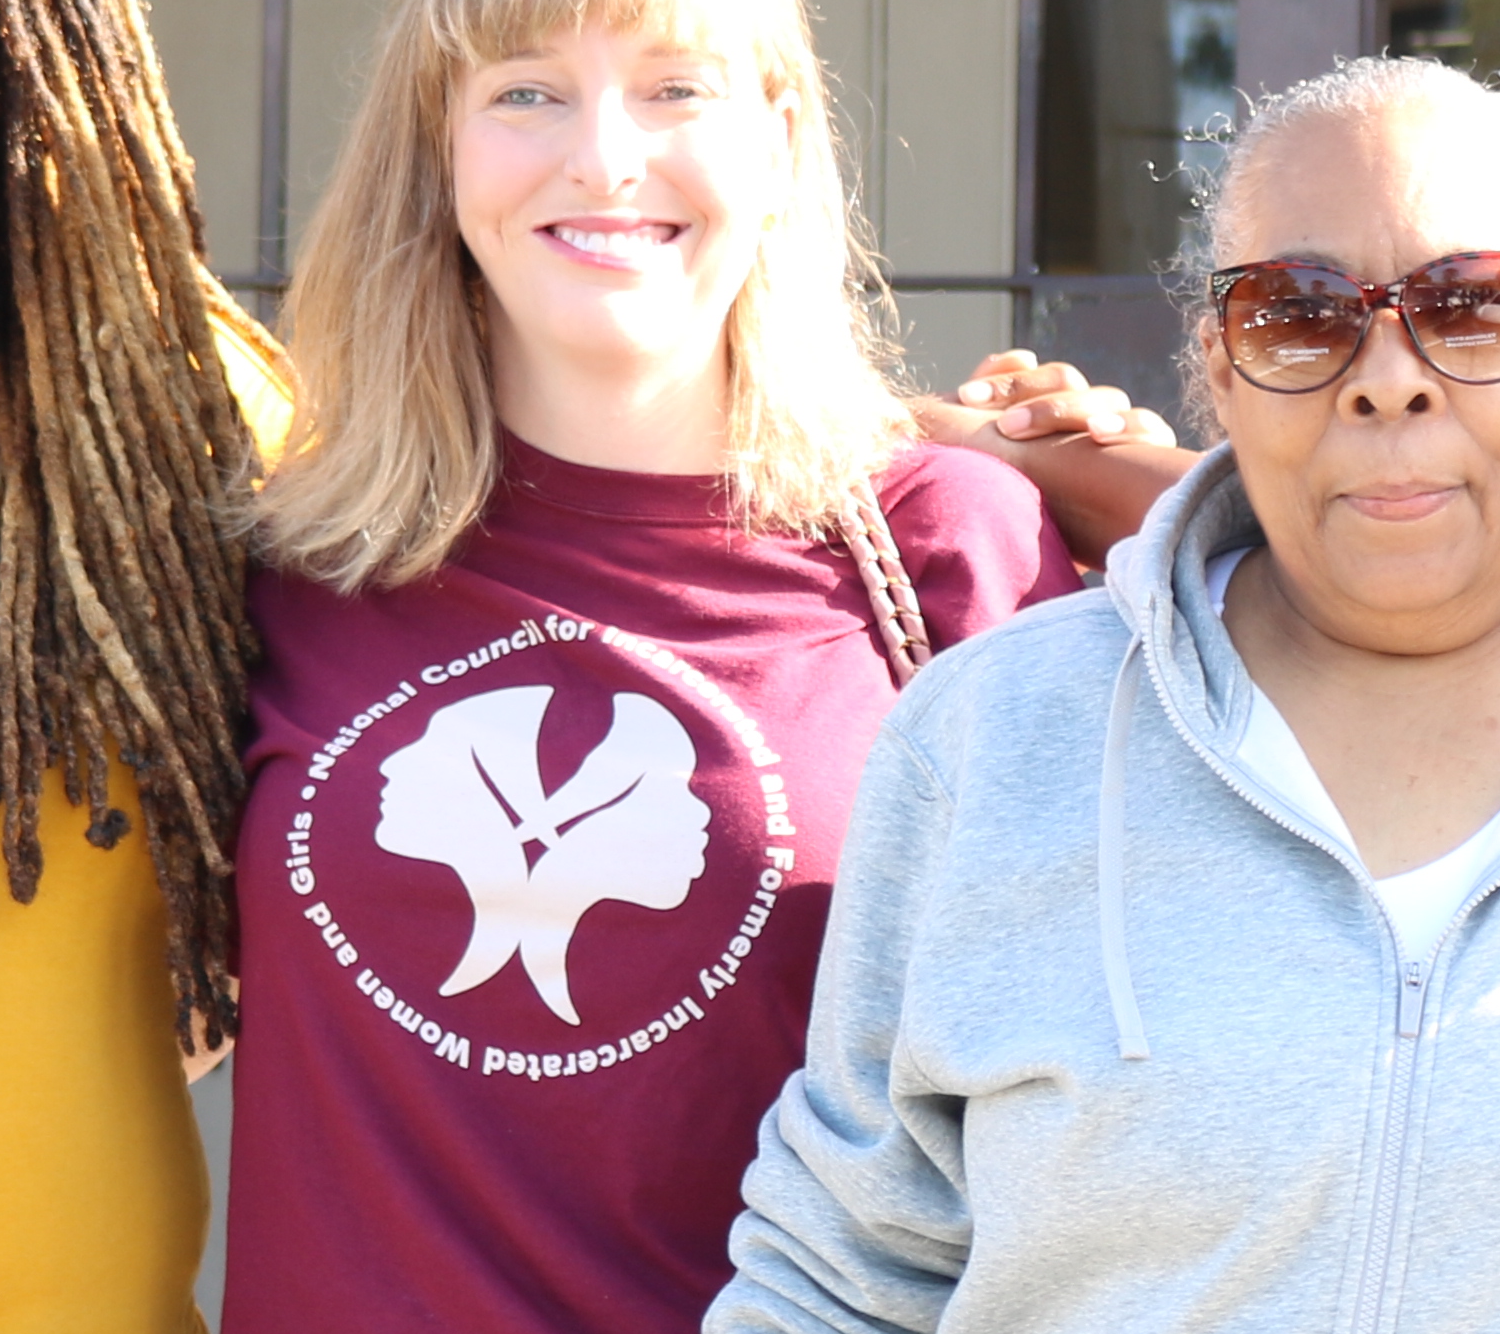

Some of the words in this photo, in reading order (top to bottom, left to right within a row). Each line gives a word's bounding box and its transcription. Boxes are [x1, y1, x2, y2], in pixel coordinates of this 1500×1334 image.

[421, 619, 545, 685] Council
[544, 614, 595, 642] for
[308, 681, 418, 781] National
[601, 625, 781, 768] Incarcerated
[760, 774, 796, 836] and
[286, 811, 316, 896] Girls
[304, 901, 359, 967] and
[699, 846, 795, 1000] Formerly
[356, 968, 471, 1069] Women
[482, 996, 705, 1082] Incarcerated
